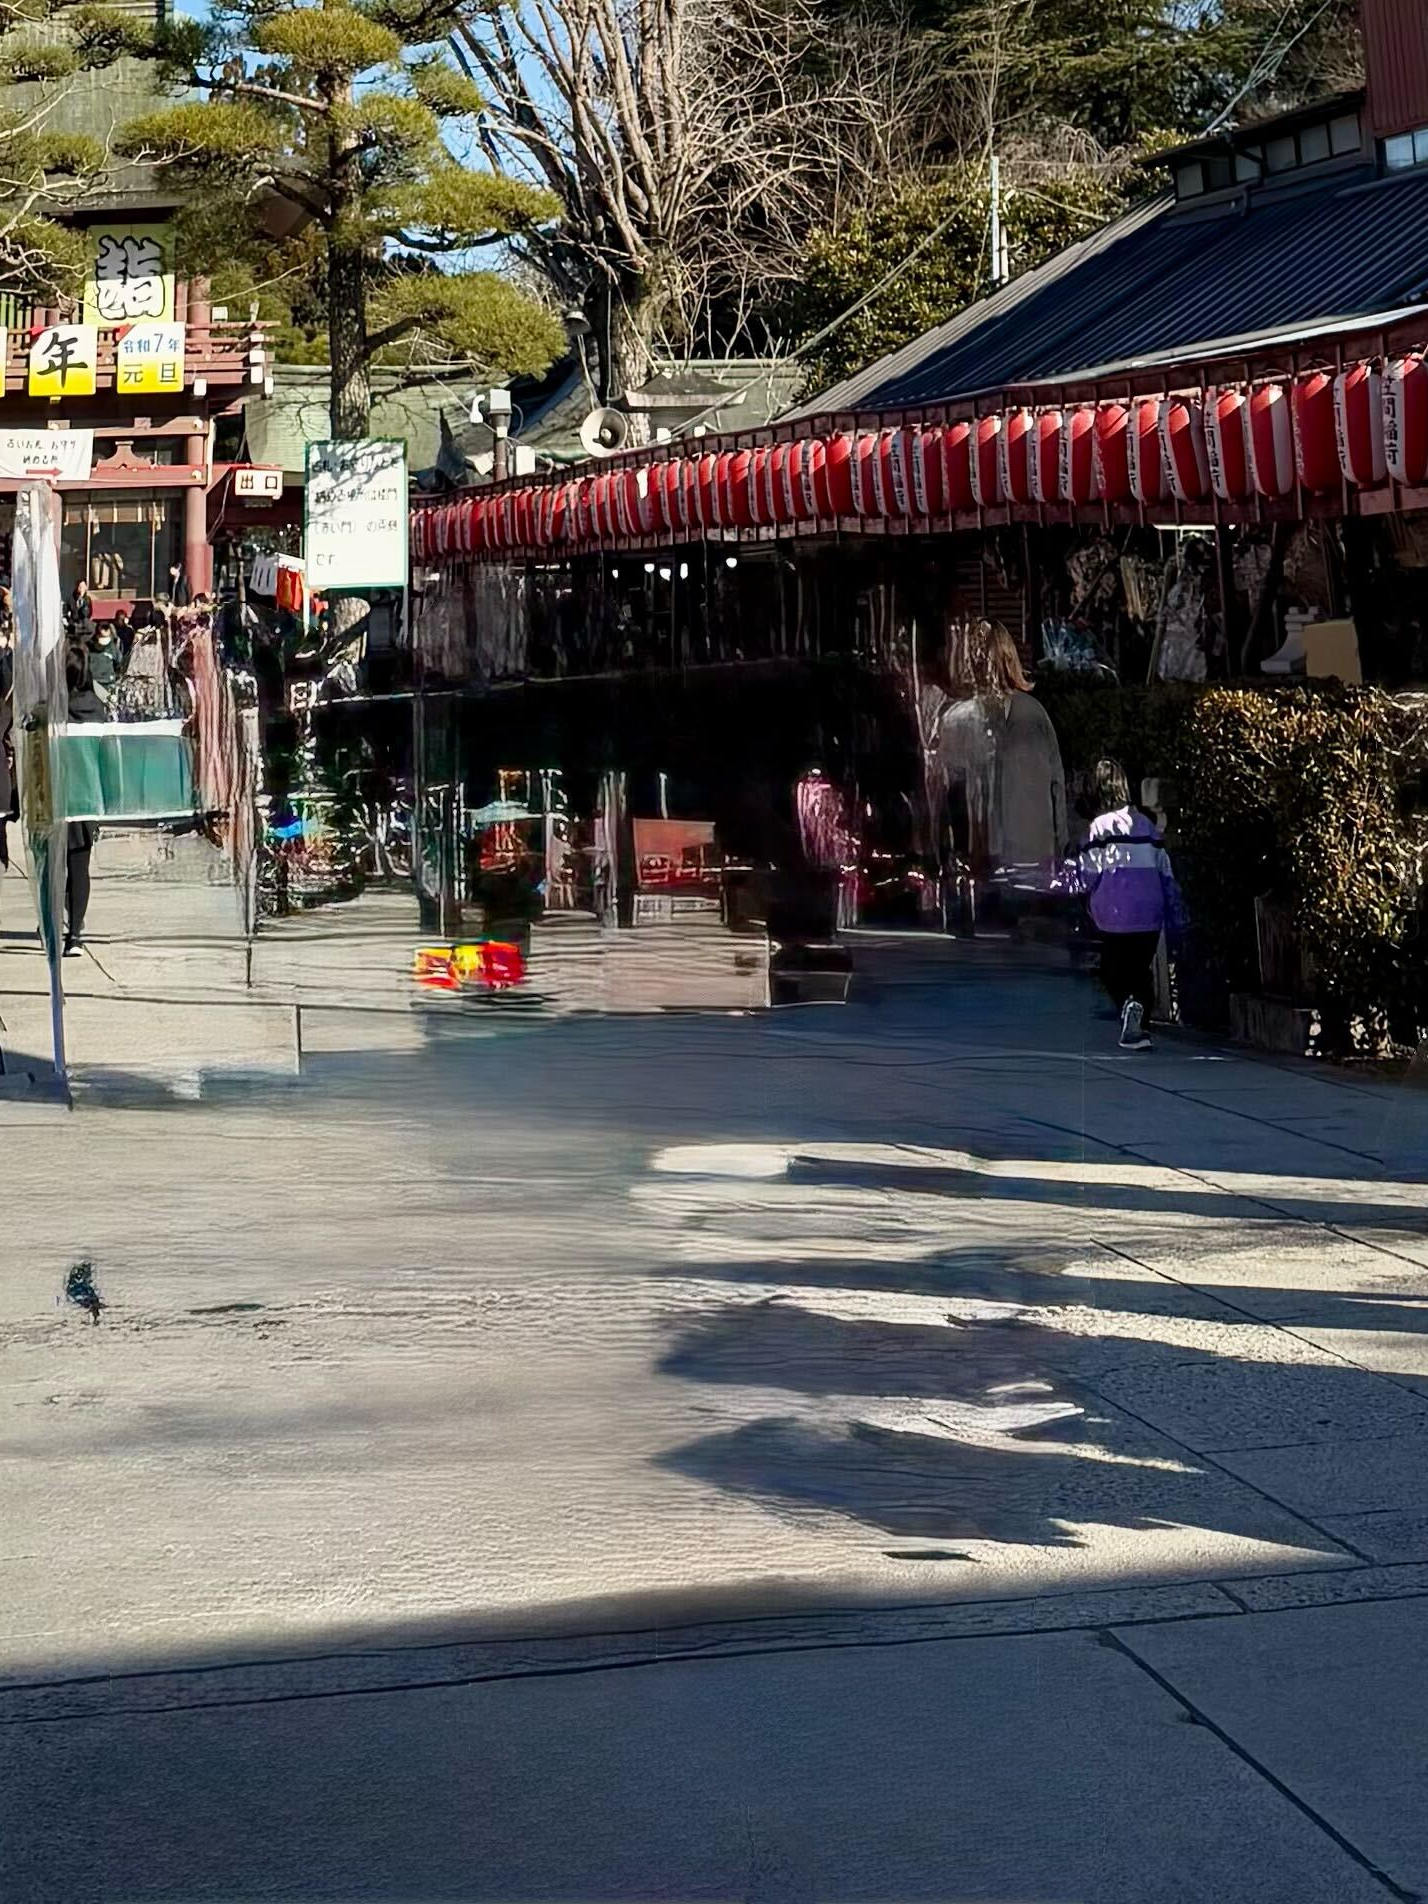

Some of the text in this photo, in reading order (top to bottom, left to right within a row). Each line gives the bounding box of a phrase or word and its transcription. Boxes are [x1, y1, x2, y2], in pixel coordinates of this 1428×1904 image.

[95, 234, 166, 322] 詣
[123, 332, 180, 353] 令和7年
[123, 361, 179, 385] 元旦
[1381, 374, 1400, 466] 笠間稲荷
[240, 473, 278, 490] 出口
